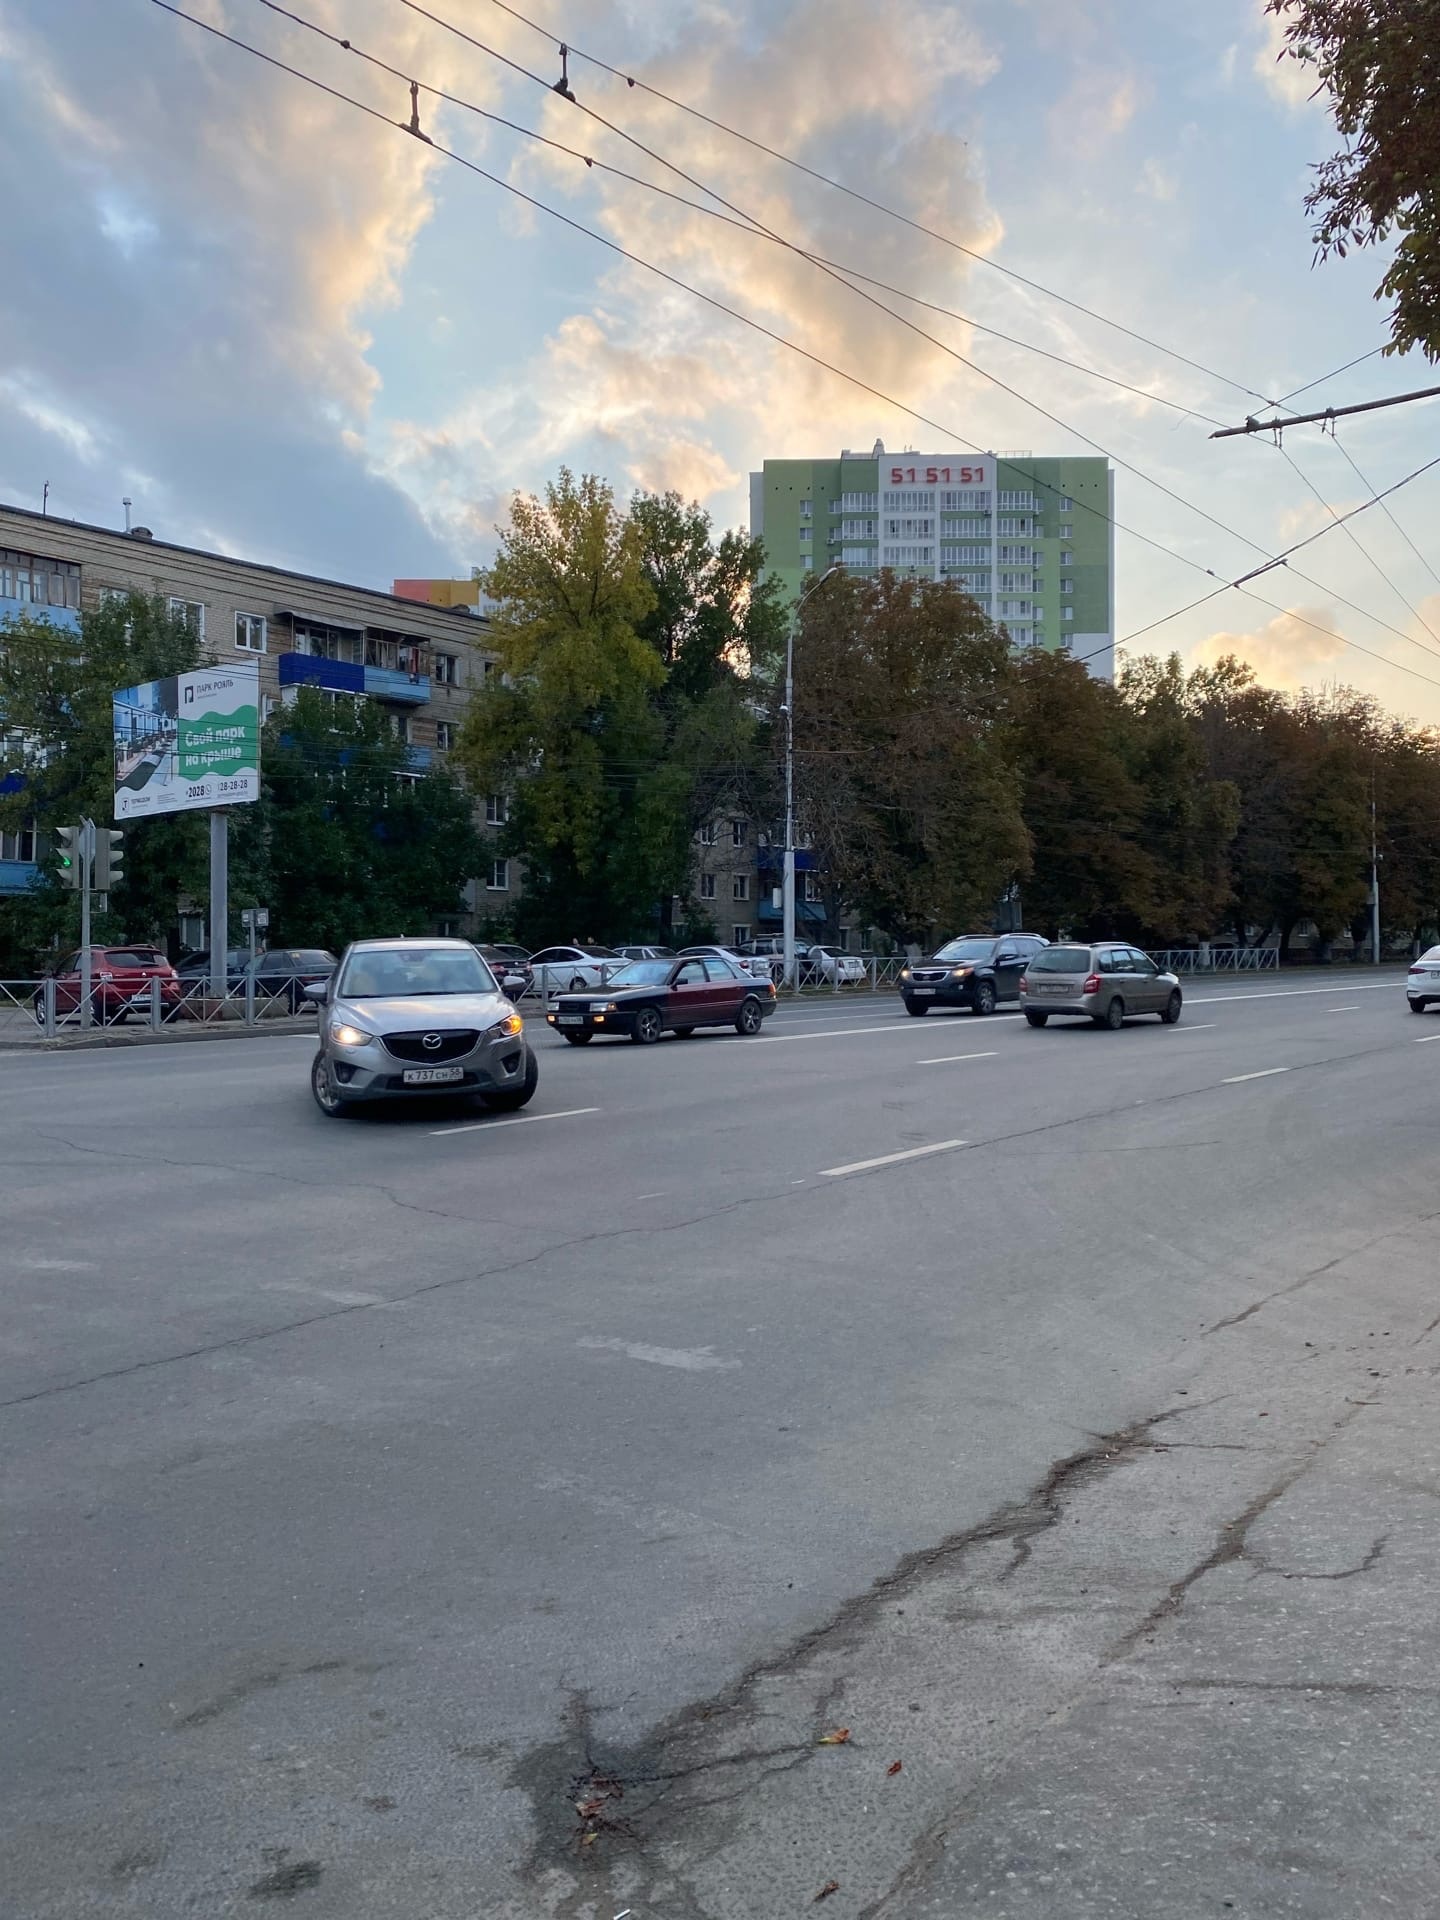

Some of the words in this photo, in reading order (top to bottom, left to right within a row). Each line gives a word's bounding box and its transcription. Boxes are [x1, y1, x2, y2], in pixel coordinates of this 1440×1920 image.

[891, 467, 915, 484] 51
[926, 467, 950, 484] 51
[960, 467, 984, 483] 51
[197, 683, 212, 694] ПАРК
[214, 680, 234, 690] РОЯЛЬ
[185, 727, 213, 747] Свой
[216, 726, 245, 744] парк
[185, 754, 199, 767] на
[201, 746, 242, 767] крыше
